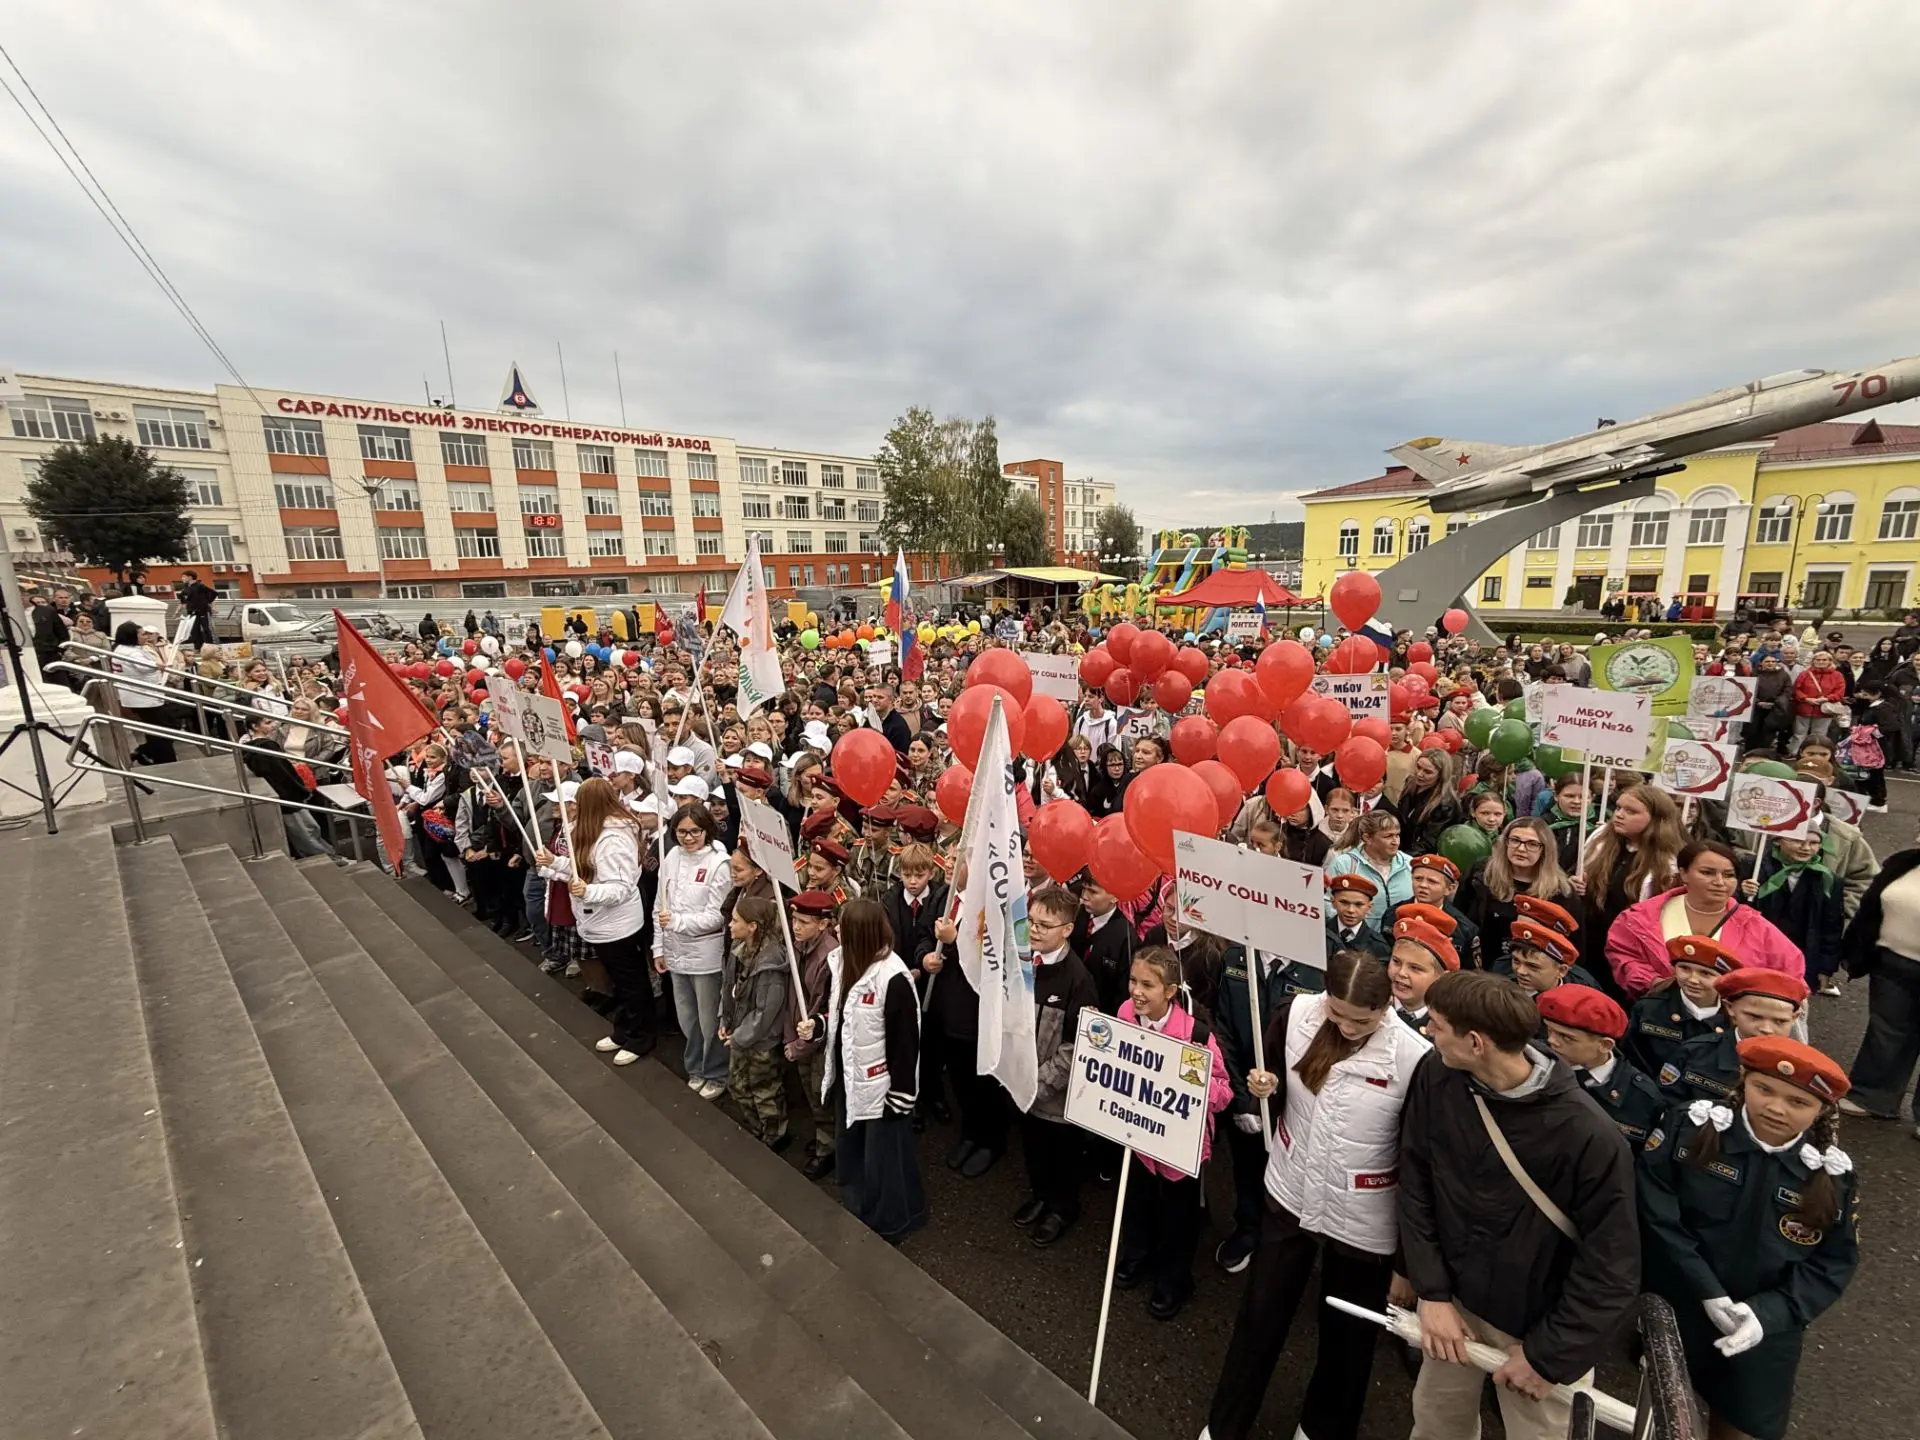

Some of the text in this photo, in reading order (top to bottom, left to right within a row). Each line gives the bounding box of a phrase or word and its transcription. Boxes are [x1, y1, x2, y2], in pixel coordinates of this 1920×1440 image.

[1832, 374, 1888, 408] 70
[277, 397, 712, 452] САРАПУЛЬСКИЙ ЭЛЕКТРОГЕНЕРАТОРНЫЙ ЗАВОД
[1041, 670, 1058, 678] СОШ
[1333, 682, 1362, 693] МБОУ
[1557, 714, 1634, 733] ЛИЦЕЙ №26
[1576, 706, 1613, 719] МБОУ
[1179, 867, 1320, 920] МБОУ СОШ №25
[1118, 1040, 1164, 1073] МБОУ
[1098, 1098, 1166, 1137] г. Сарапул
